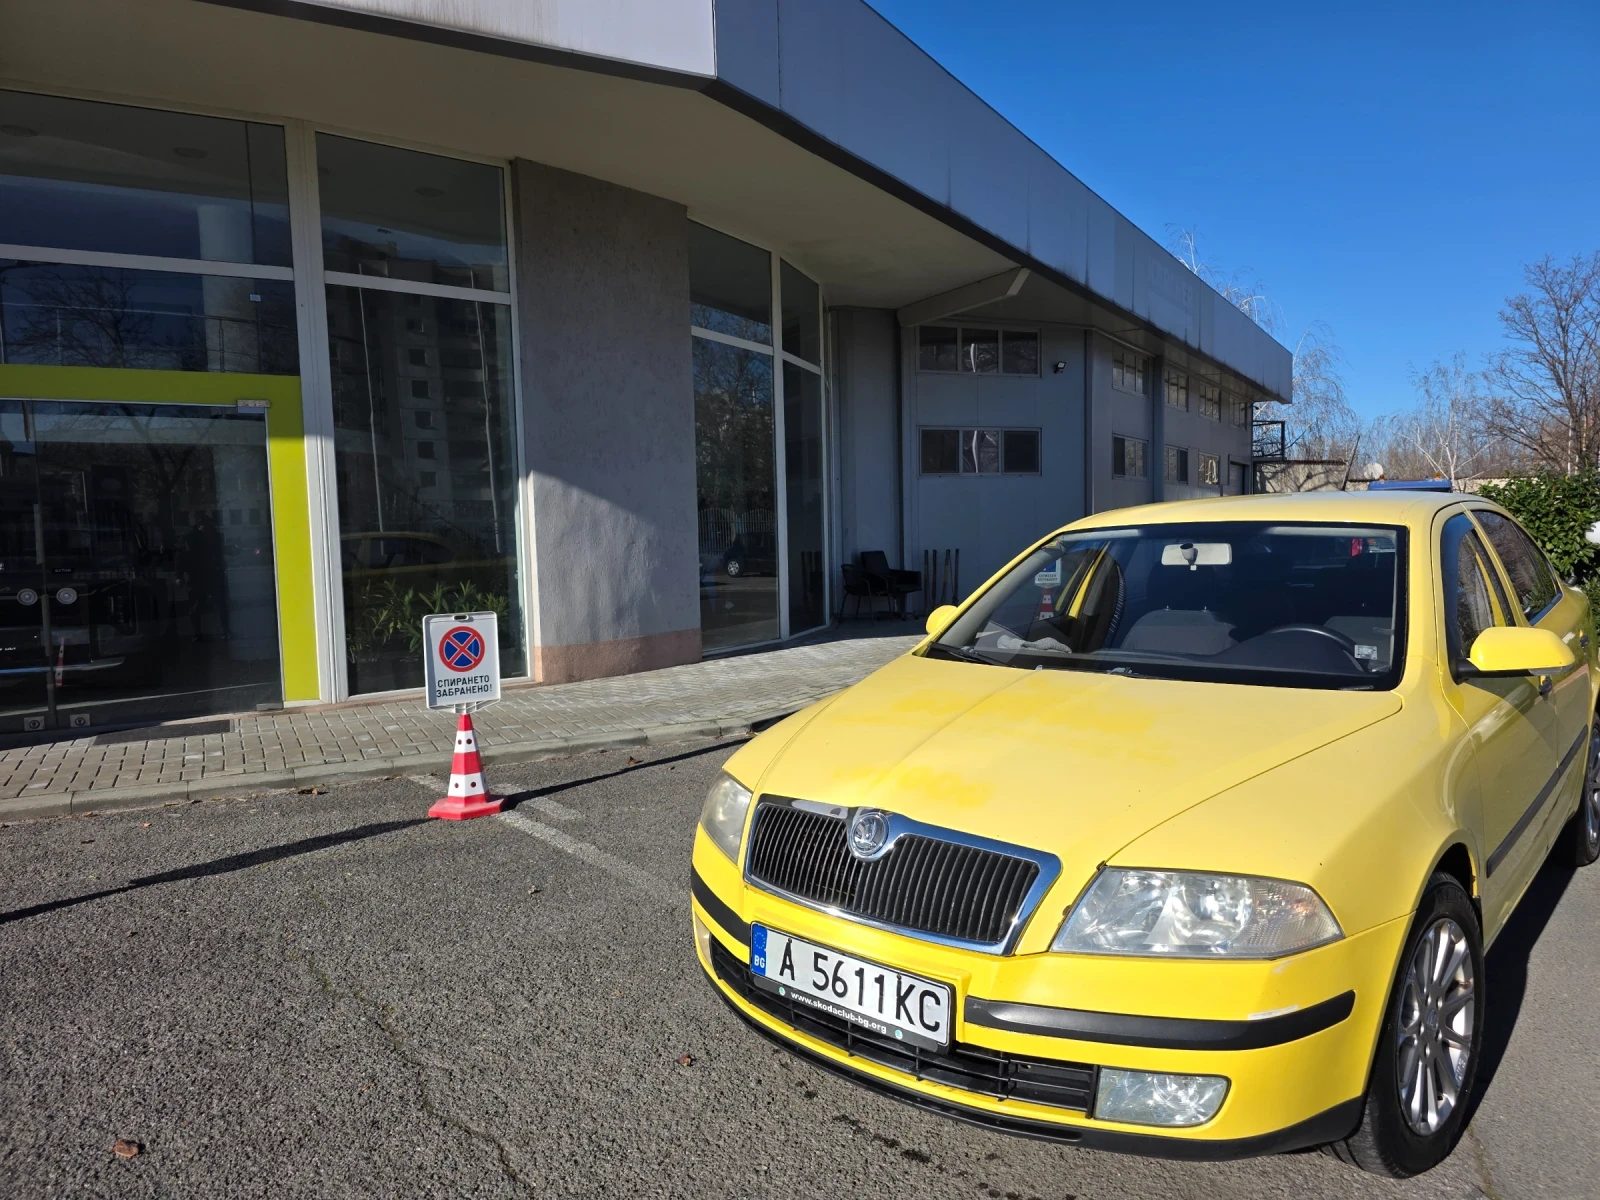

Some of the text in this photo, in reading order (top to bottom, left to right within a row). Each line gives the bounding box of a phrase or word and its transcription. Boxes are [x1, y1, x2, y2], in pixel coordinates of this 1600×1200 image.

[437, 675, 490, 688] СПИРАНЕТО
[436, 684, 493, 698] ЗАБРАНЕНО!
[754, 954, 766, 969] BG
[790, 991, 888, 1035] www.skodaclub-bg.org
